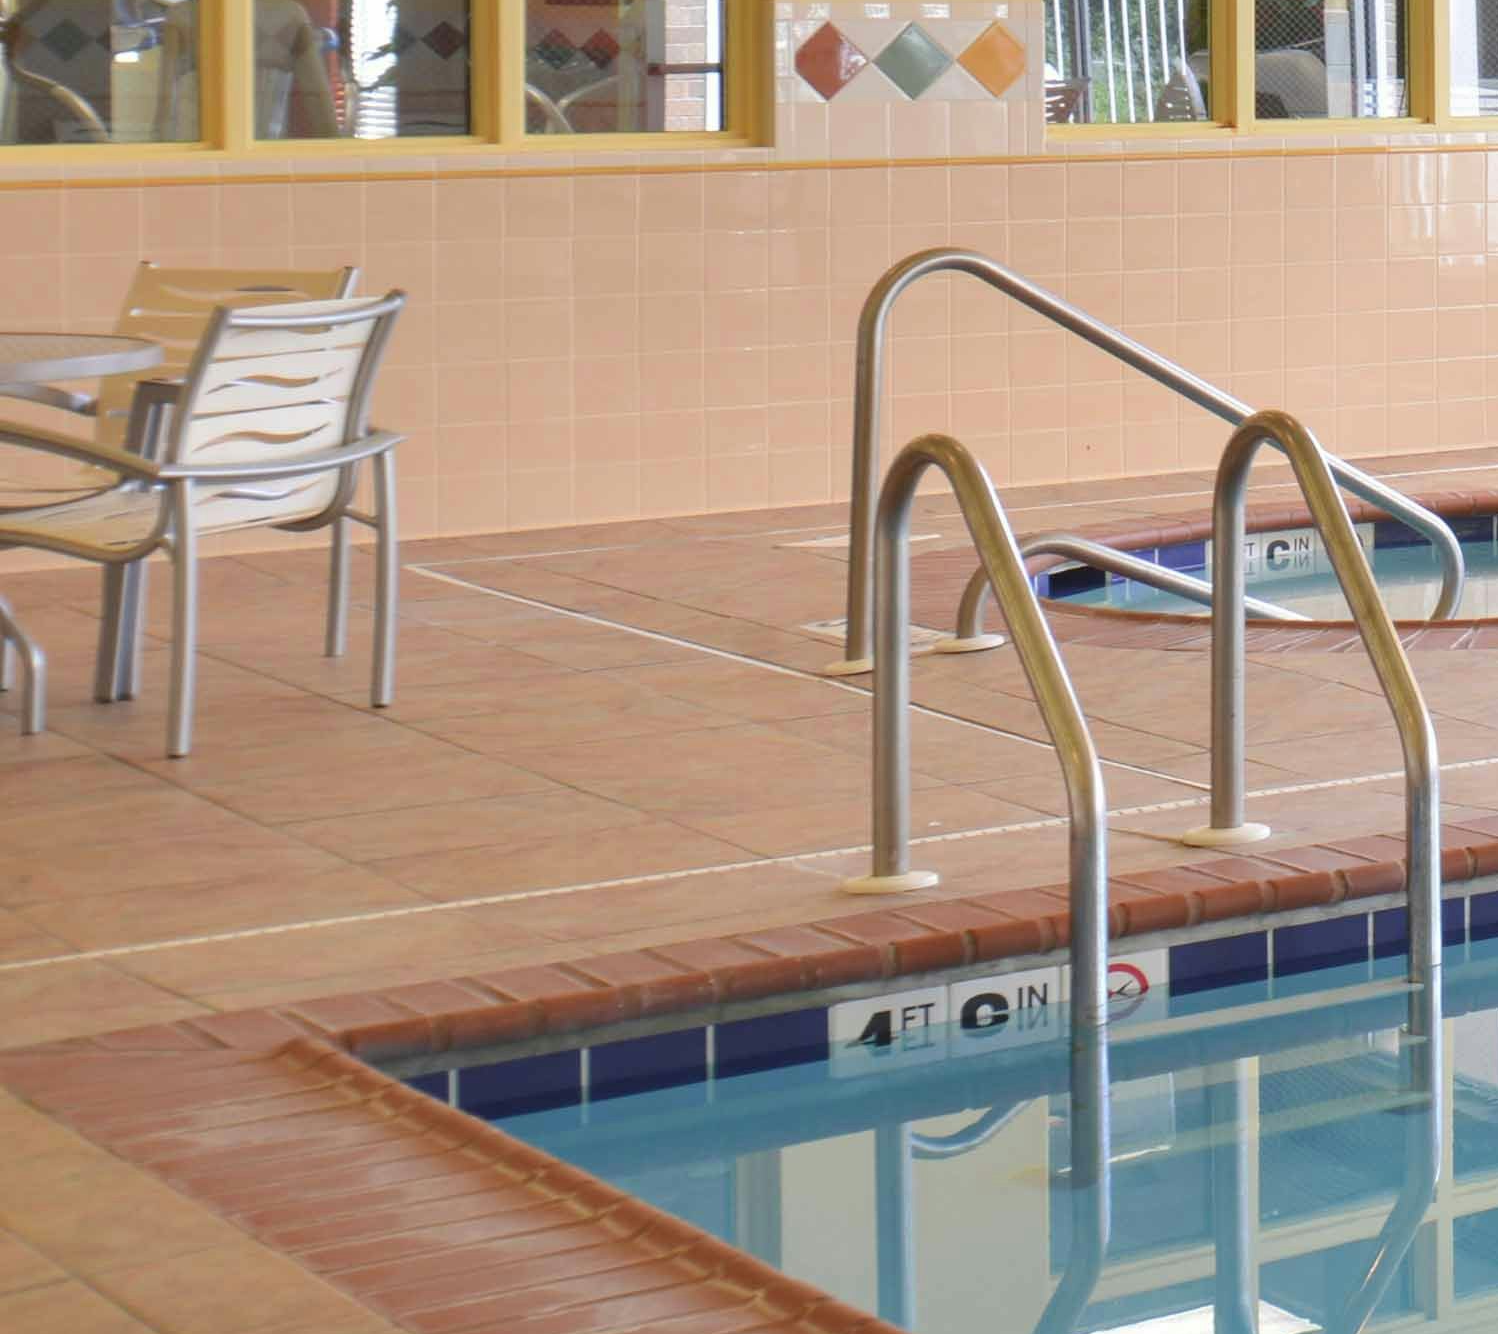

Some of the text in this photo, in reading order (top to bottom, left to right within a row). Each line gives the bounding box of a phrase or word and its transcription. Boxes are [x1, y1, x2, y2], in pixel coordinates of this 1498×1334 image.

[1294, 537, 1309, 551] IN
[902, 1003, 935, 1031] FT
[1017, 983, 1048, 1010] IN
